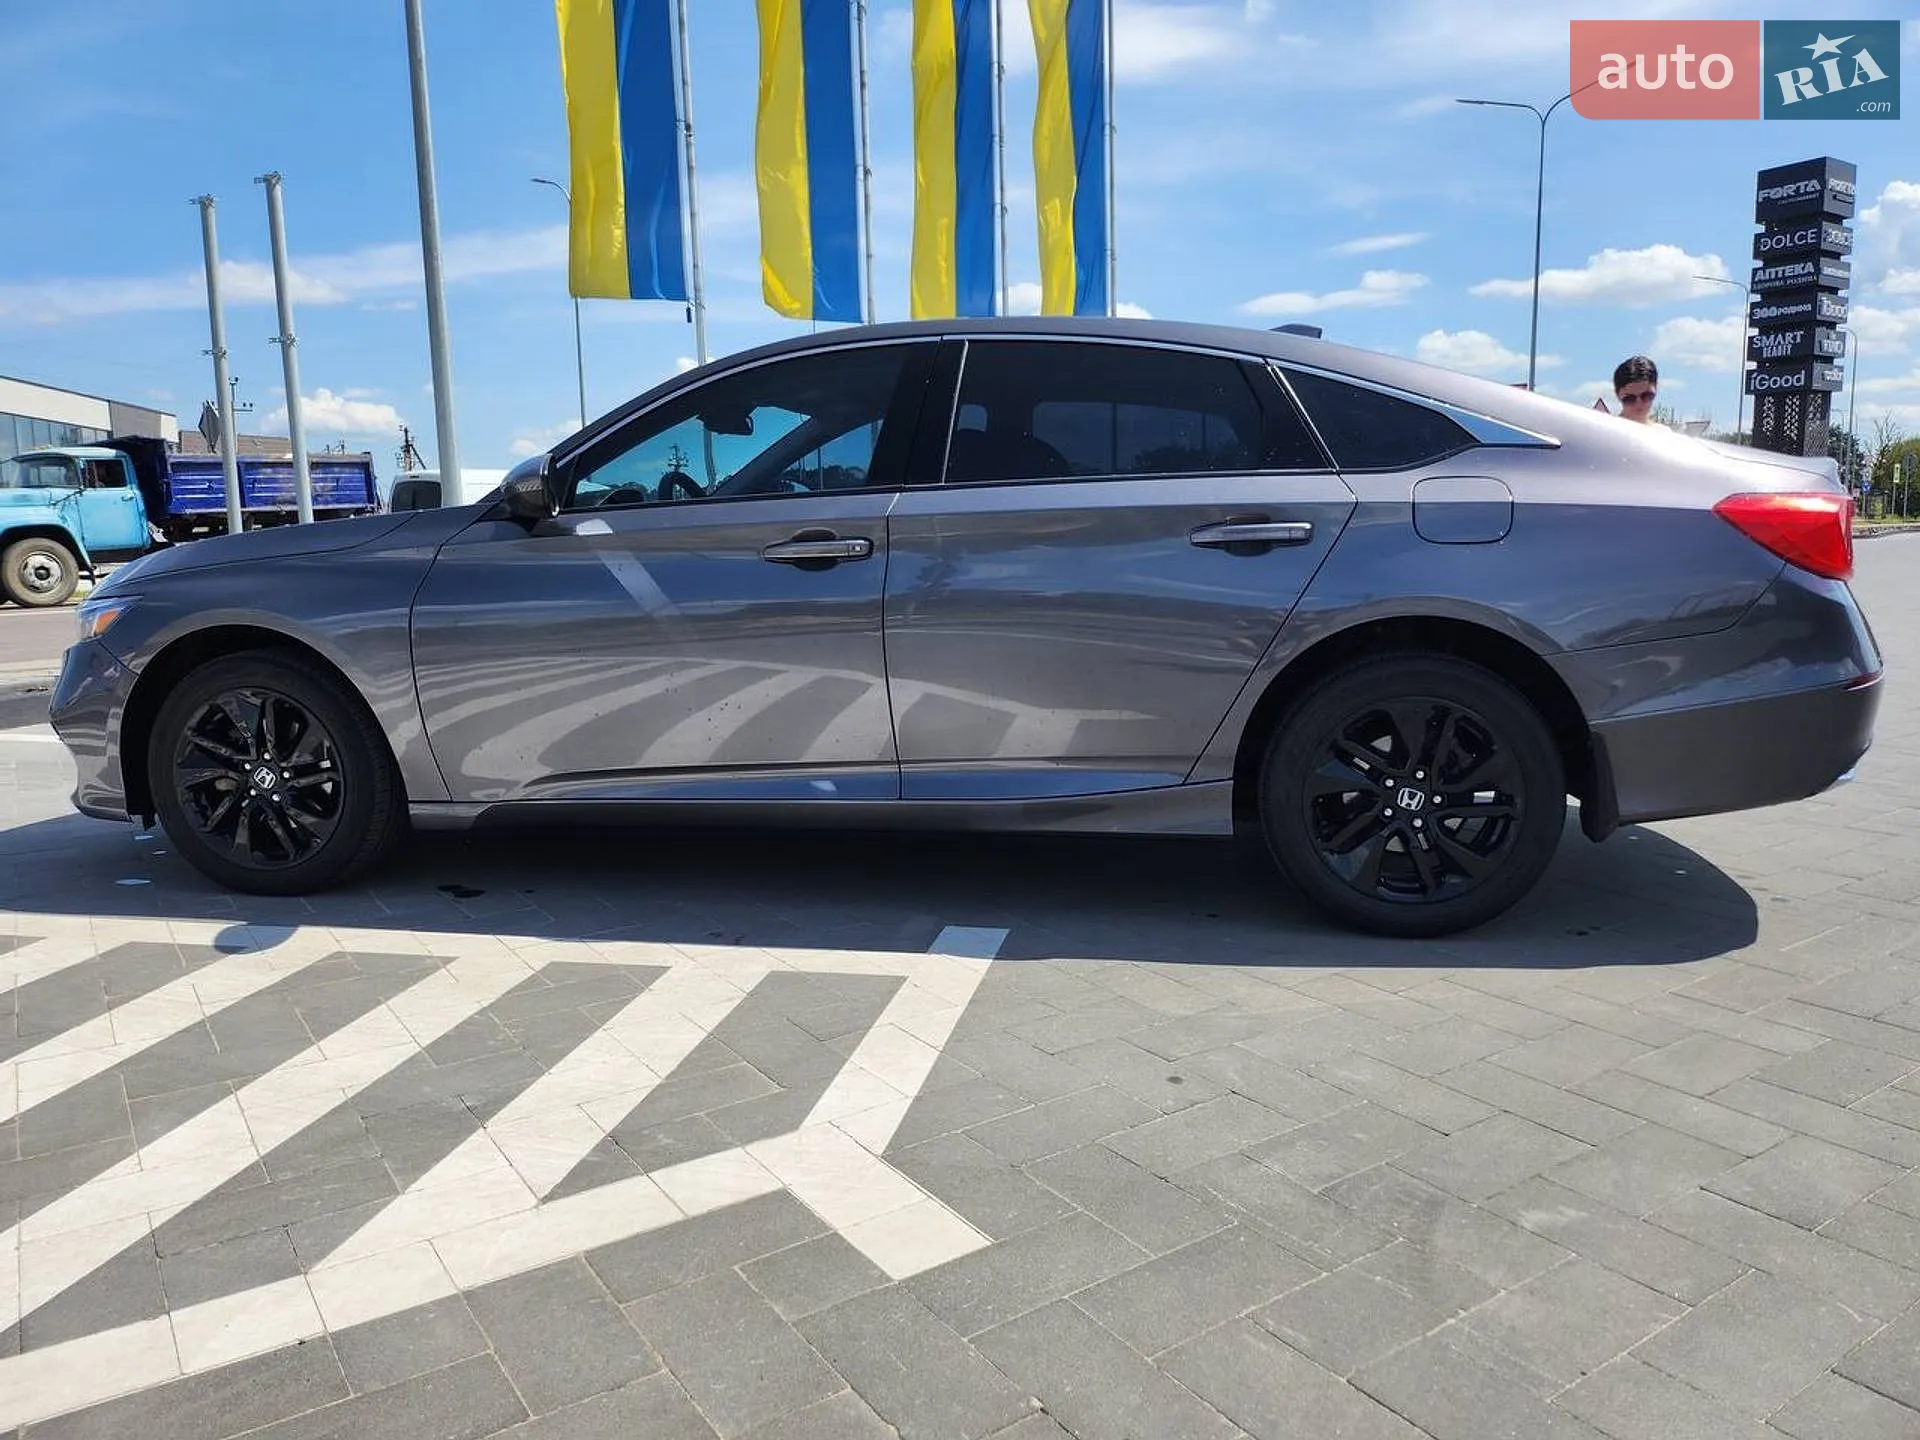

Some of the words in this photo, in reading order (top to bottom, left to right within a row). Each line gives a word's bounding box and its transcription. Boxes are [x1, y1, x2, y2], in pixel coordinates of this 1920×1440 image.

[1758, 179, 1821, 202] FORTA
[1760, 228, 1818, 251] DOLCE
[1752, 331, 1804, 348] SMART
